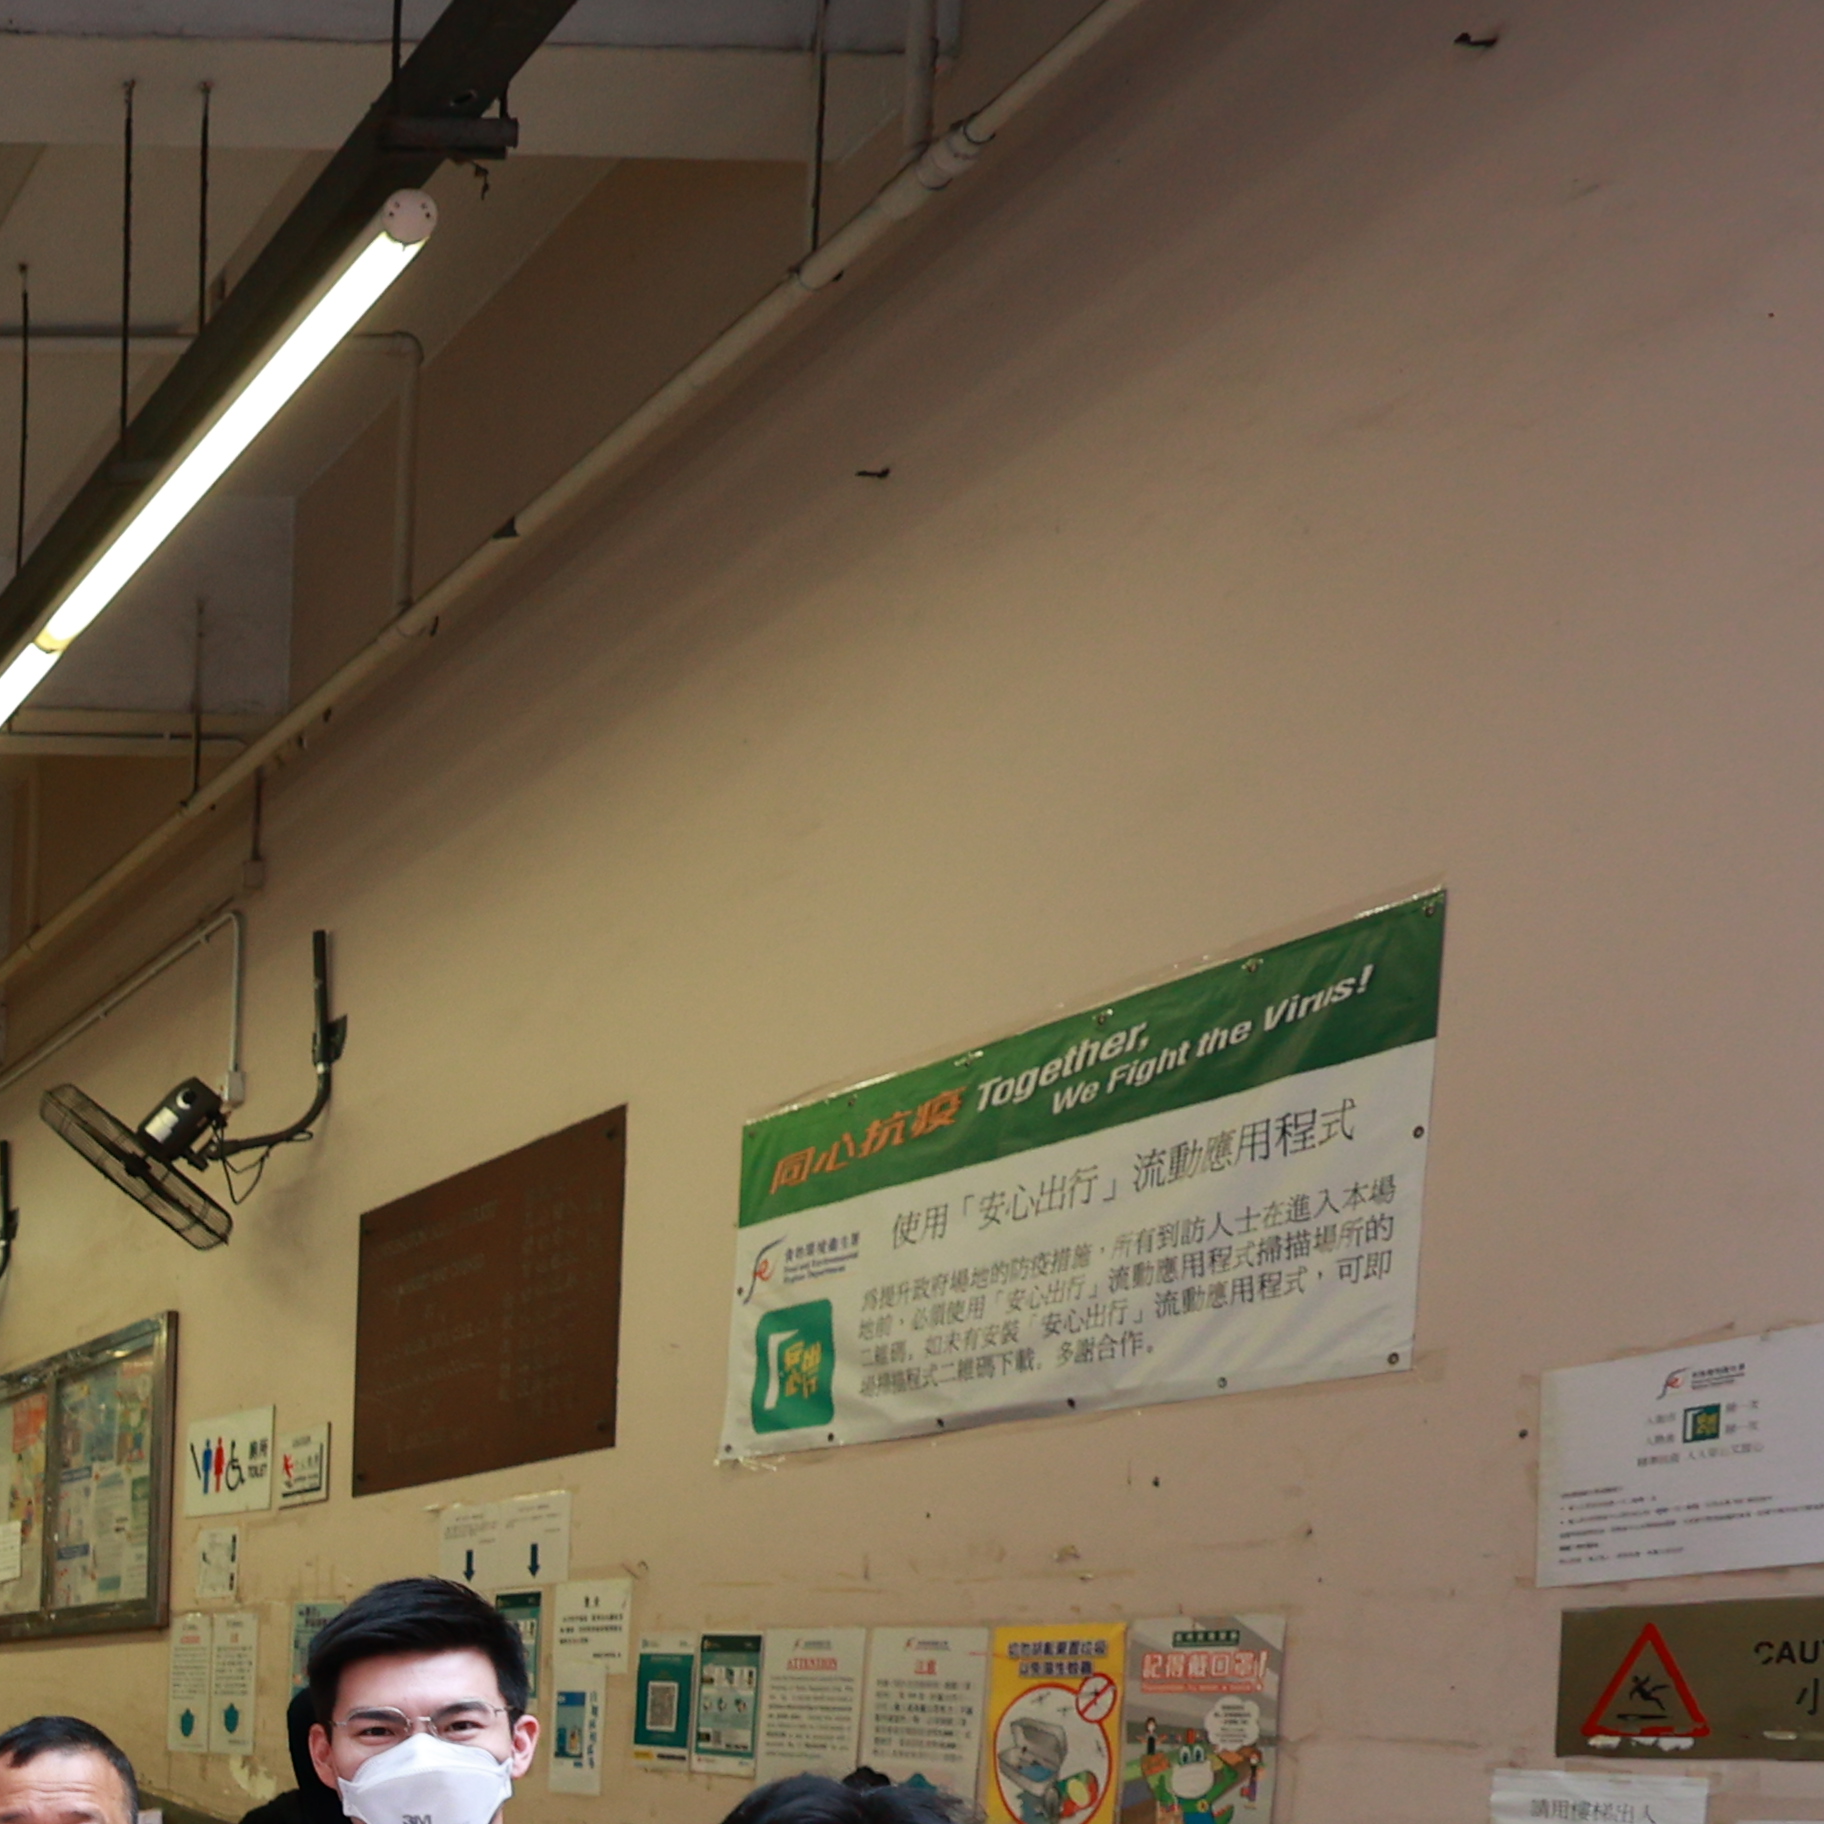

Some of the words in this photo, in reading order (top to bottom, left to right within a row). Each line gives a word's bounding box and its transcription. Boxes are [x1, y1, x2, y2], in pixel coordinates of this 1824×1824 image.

[976, 1020, 1151, 1113] Together,
[1051, 1078, 1100, 1117] We
[1105, 1042, 1191, 1099] Fight
[1196, 1018, 1252, 1059] the
[1263, 962, 1374, 1035] Virus!
[768, 1085, 969, 1196] 同心抗疫
